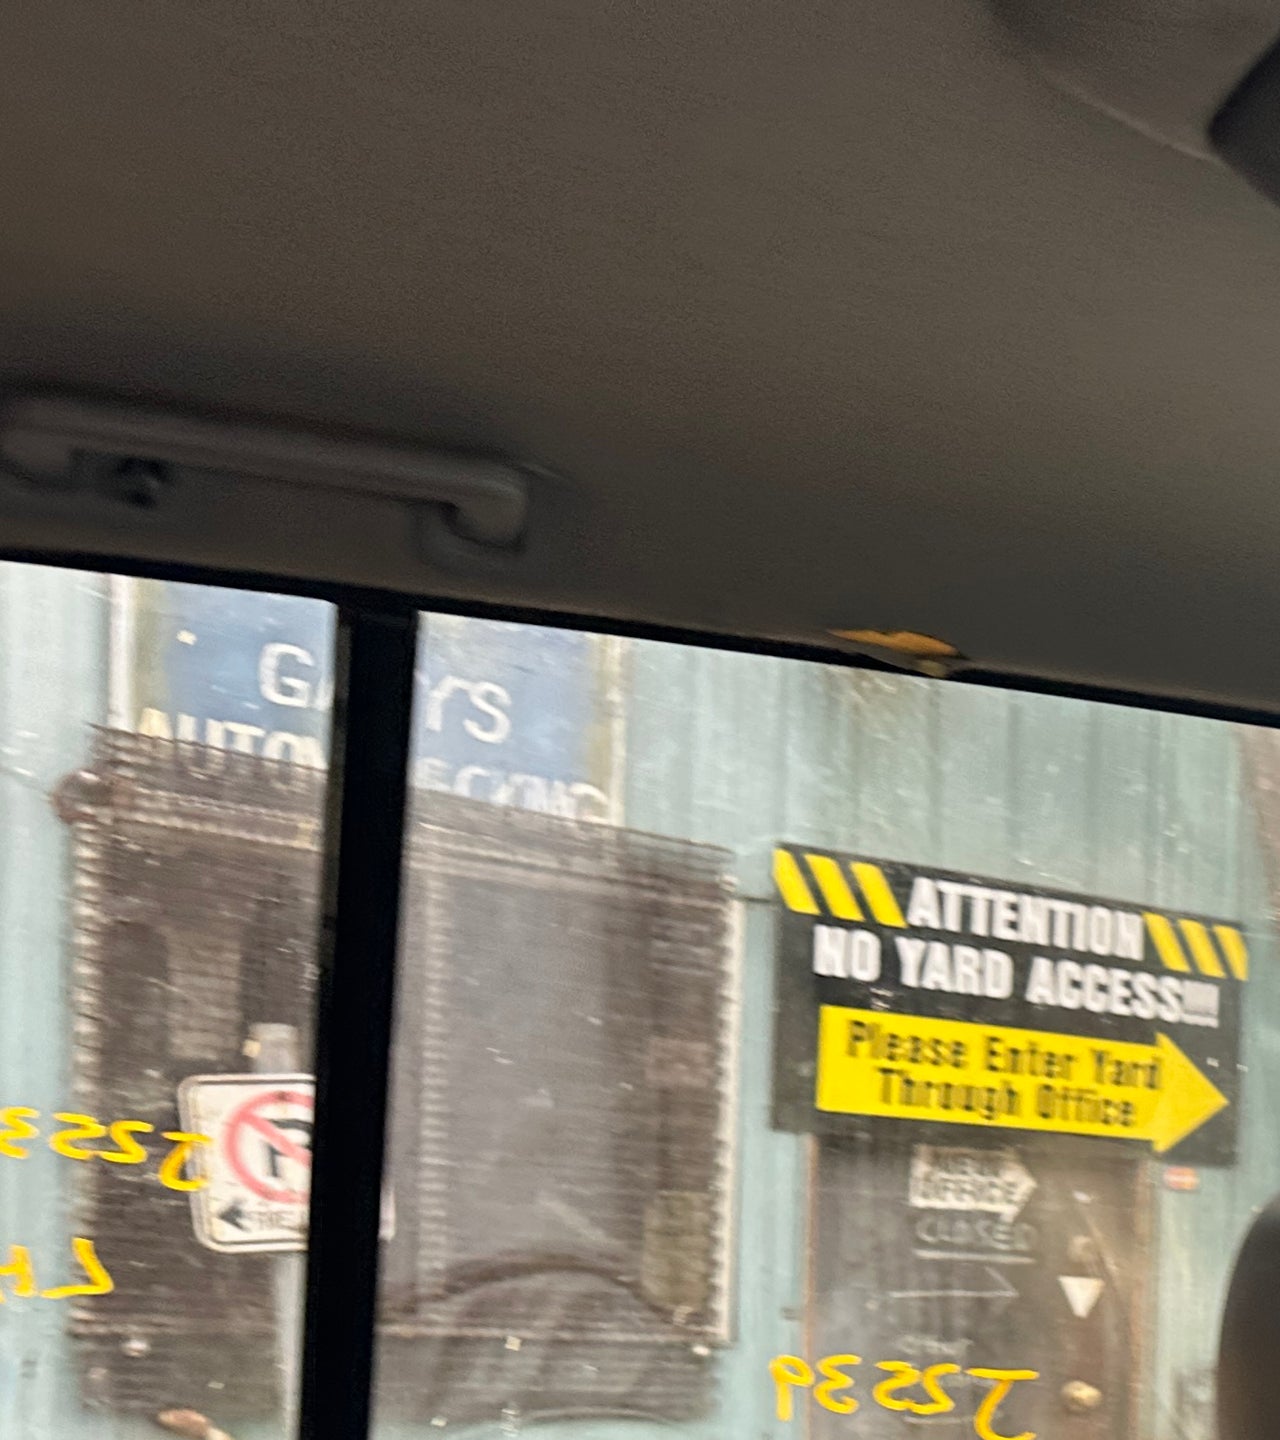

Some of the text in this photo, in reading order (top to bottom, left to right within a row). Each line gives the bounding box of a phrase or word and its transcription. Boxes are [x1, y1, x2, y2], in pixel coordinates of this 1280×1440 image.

[907, 876, 1145, 961] ATTENTION
[813, 923, 882, 983] NO
[896, 935, 1014, 1000] YARD
[847, 1020, 1163, 1091] Please Enter Yard
[874, 1067, 1137, 1128] Through Office
